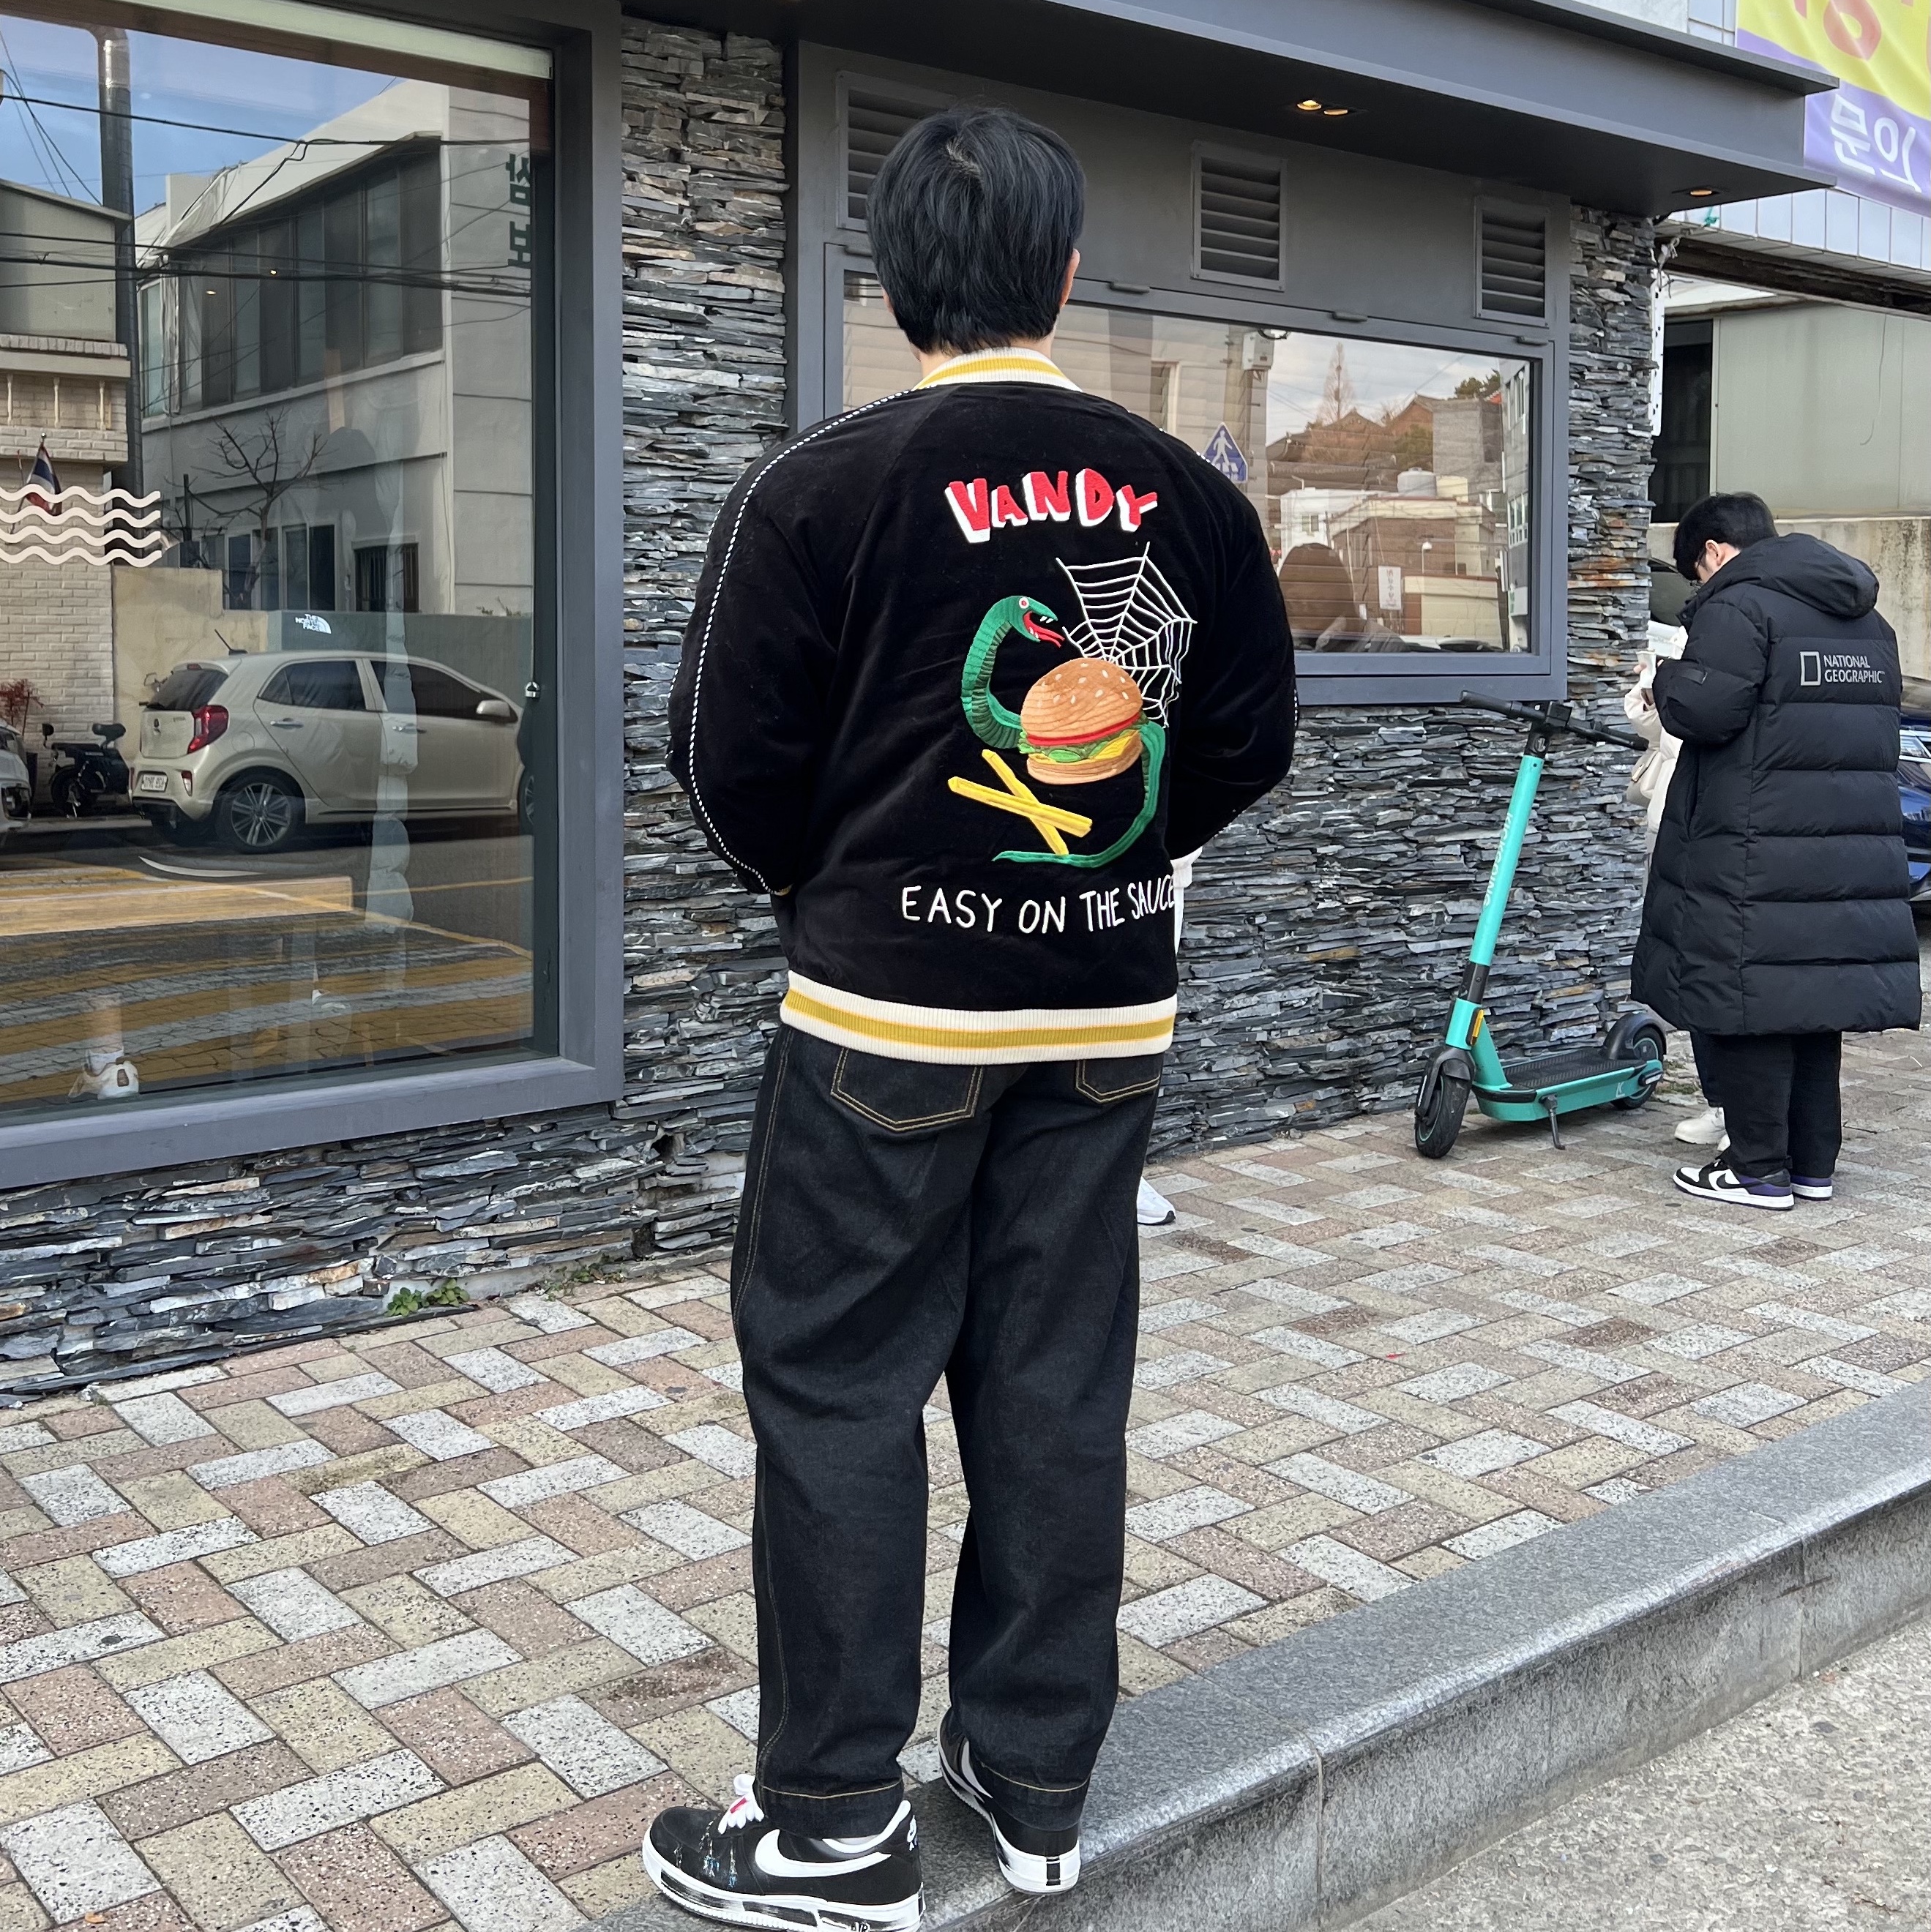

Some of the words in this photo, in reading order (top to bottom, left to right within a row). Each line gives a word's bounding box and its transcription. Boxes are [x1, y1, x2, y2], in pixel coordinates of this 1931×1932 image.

[1831, 94, 1922, 193] 문의
[944, 468, 1158, 543] VANDY
[1823, 654, 1871, 668] NATIONAL
[1824, 669, 1883, 684] GEOGRAPHIC
[902, 886, 1003, 932] EASY
[1018, 896, 1066, 934] ON
[1079, 887, 1125, 932] THE
